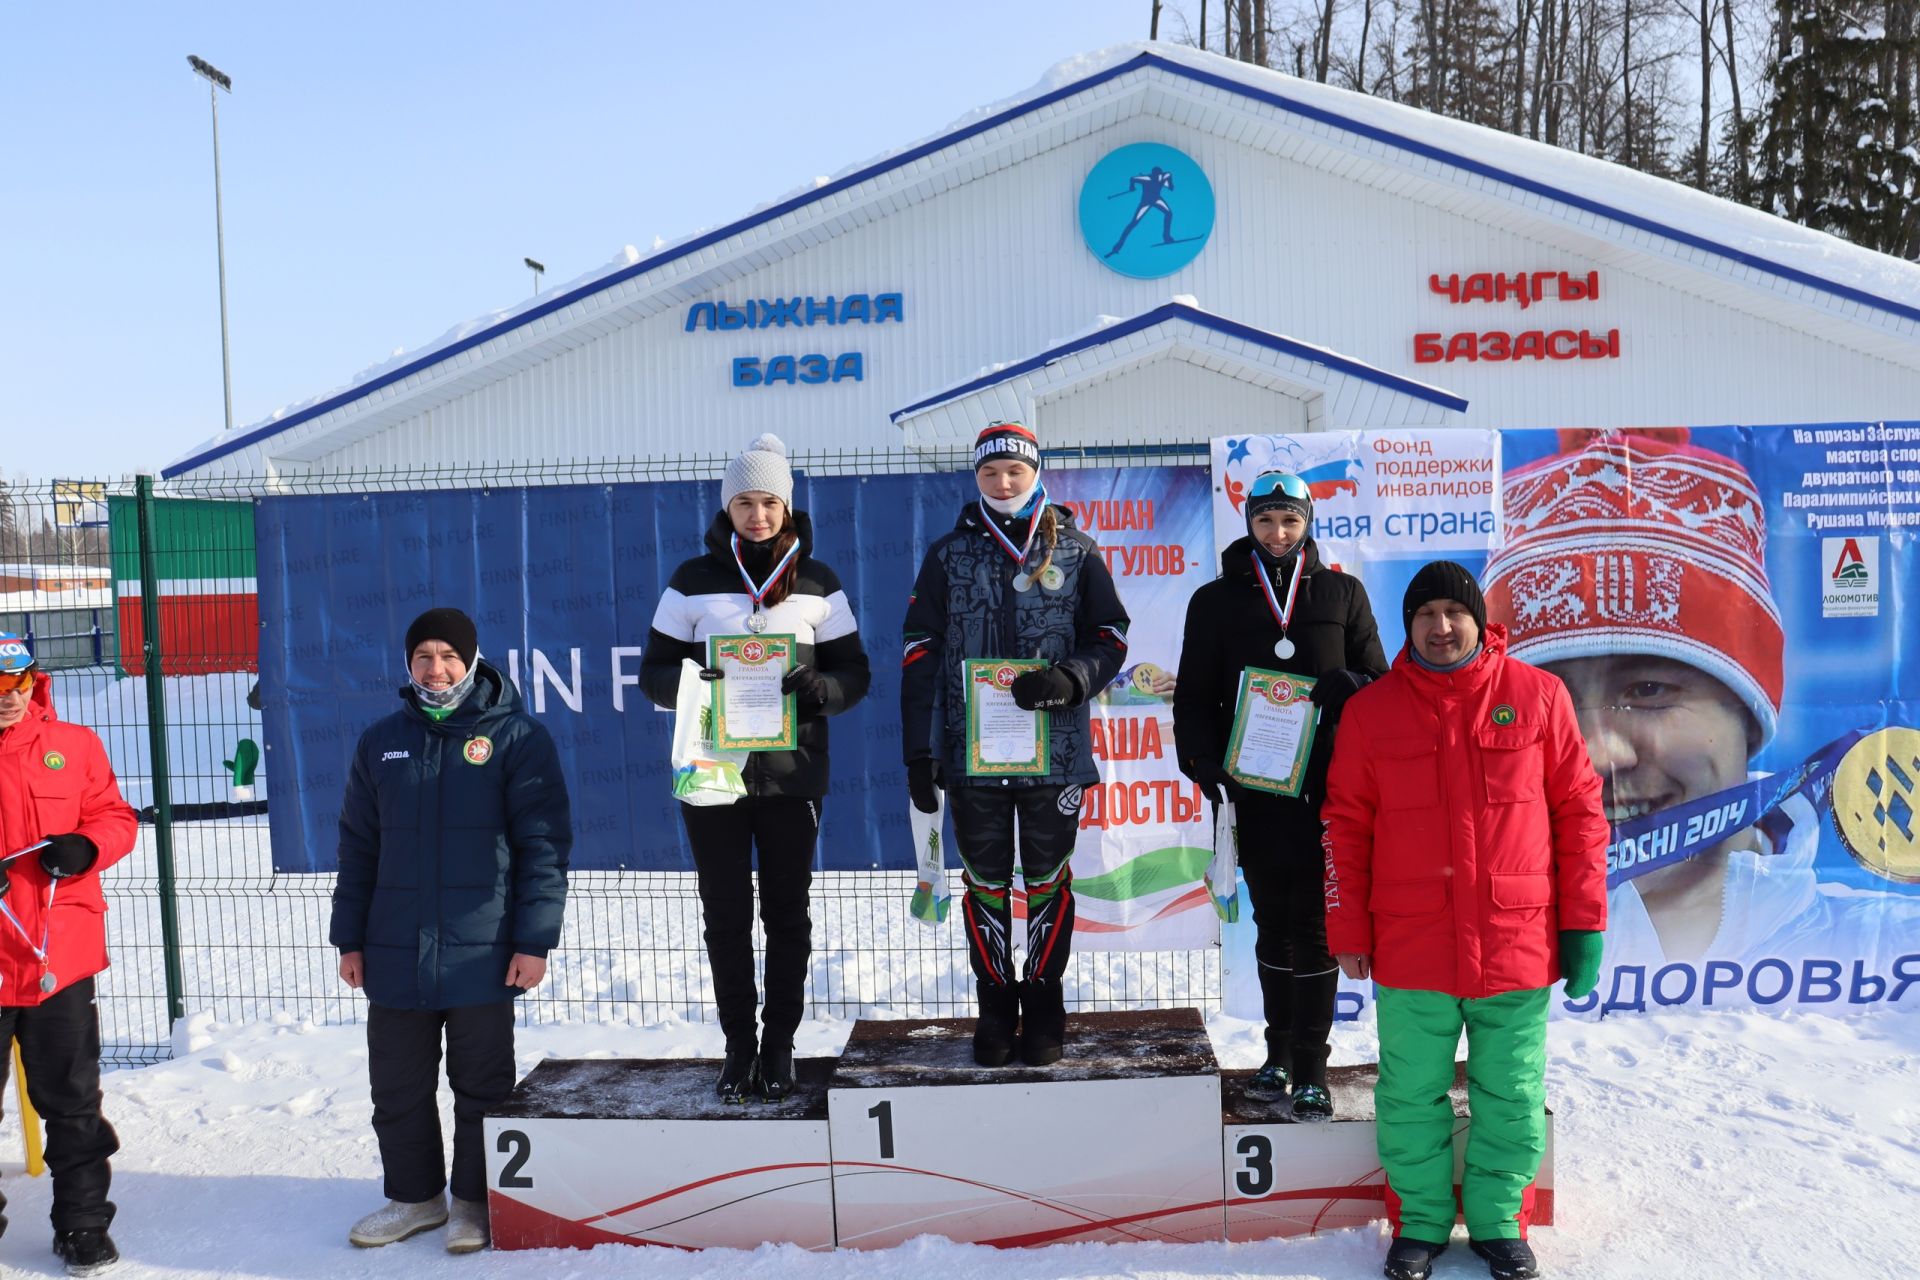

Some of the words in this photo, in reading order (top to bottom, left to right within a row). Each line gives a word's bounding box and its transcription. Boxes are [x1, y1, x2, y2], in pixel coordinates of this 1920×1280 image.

[1429, 270, 1599, 310] ЧАҢГЫ
[685, 292, 903, 332] ЛЫЖНАЯ
[1414, 328, 1620, 363] БАЗАСЫ
[732, 352, 863, 387] БАЗА
[975, 437, 1039, 465] ATARSTAN
[1373, 438, 1432, 456] Фонд
[1815, 429, 1865, 444] призы
[1376, 458, 1493, 478] поддержки
[1826, 449, 1887, 464] мастера
[1376, 479, 1493, 498] инвалидов
[1802, 470, 1894, 488] двукратного
[1783, 489, 1913, 508] Паралимпийских
[1385, 510, 1496, 541] страна
[1808, 512, 1864, 529] Рушана
[1823, 594, 1878, 604] ЛОКОМОТИВ
[1091, 717, 1163, 760] АША
[1080, 780, 1202, 831] ДОСТЬ!
[1606, 822, 1679, 875] SOCHI
[1683, 798, 1748, 848] 2014
[868, 1100, 895, 1159] 1
[496, 1129, 533, 1188] 2
[1236, 1134, 1273, 1196] 3
